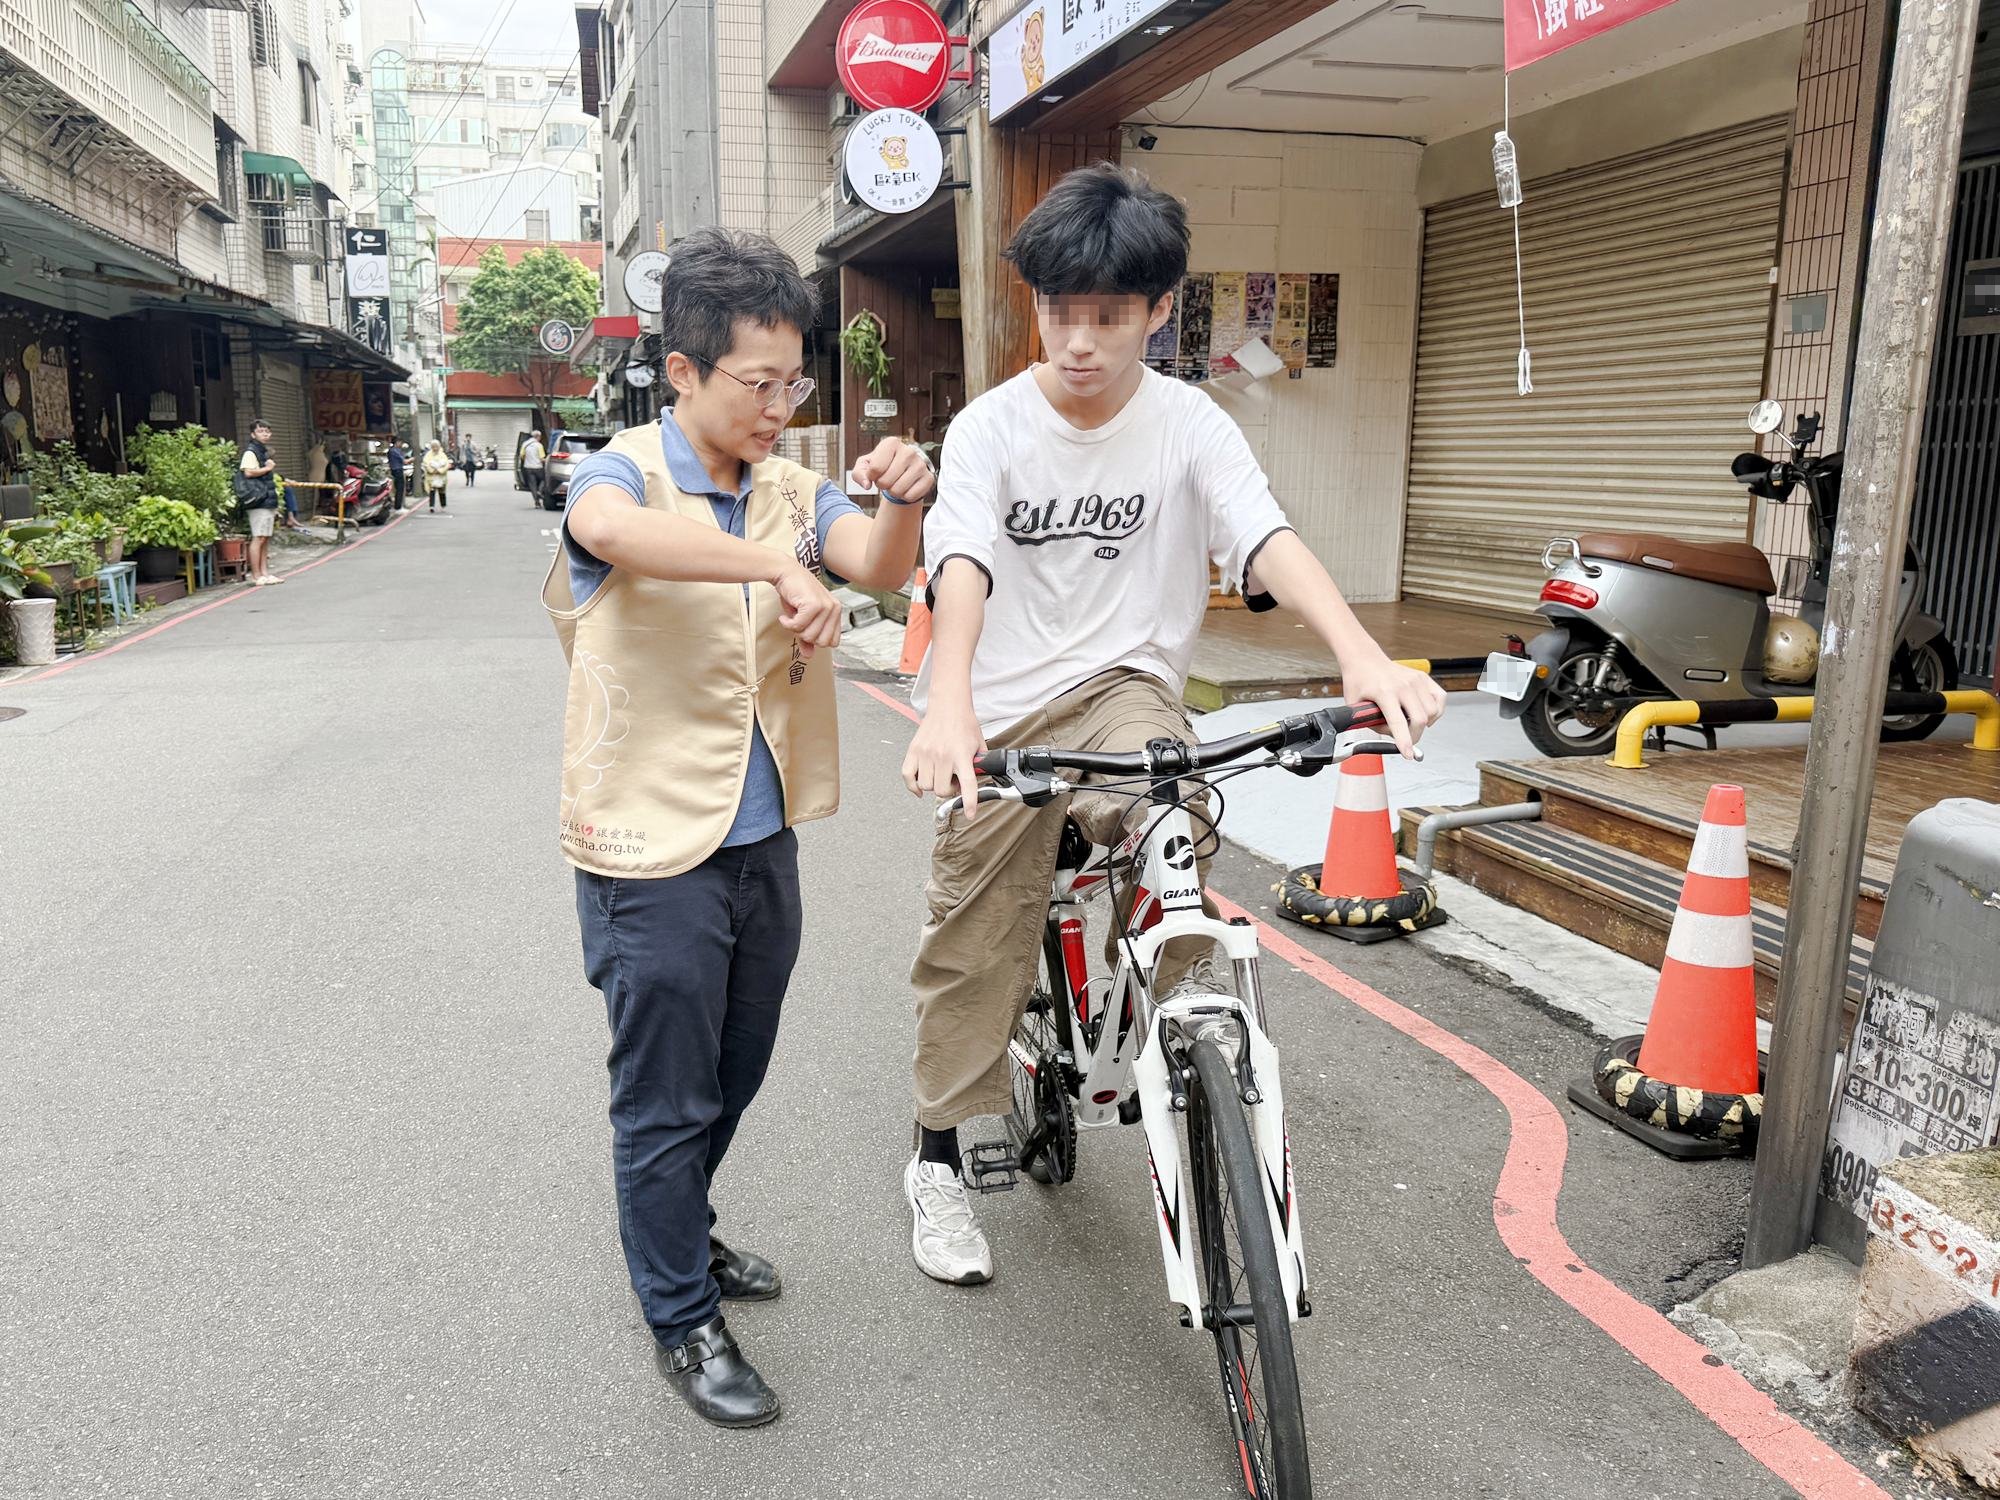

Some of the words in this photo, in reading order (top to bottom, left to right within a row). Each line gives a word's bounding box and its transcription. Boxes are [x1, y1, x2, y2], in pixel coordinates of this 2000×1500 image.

[857, 40, 935, 62] Budweiser
[316, 410, 362, 428] 500
[1163, 887, 1201, 900] GIAN
